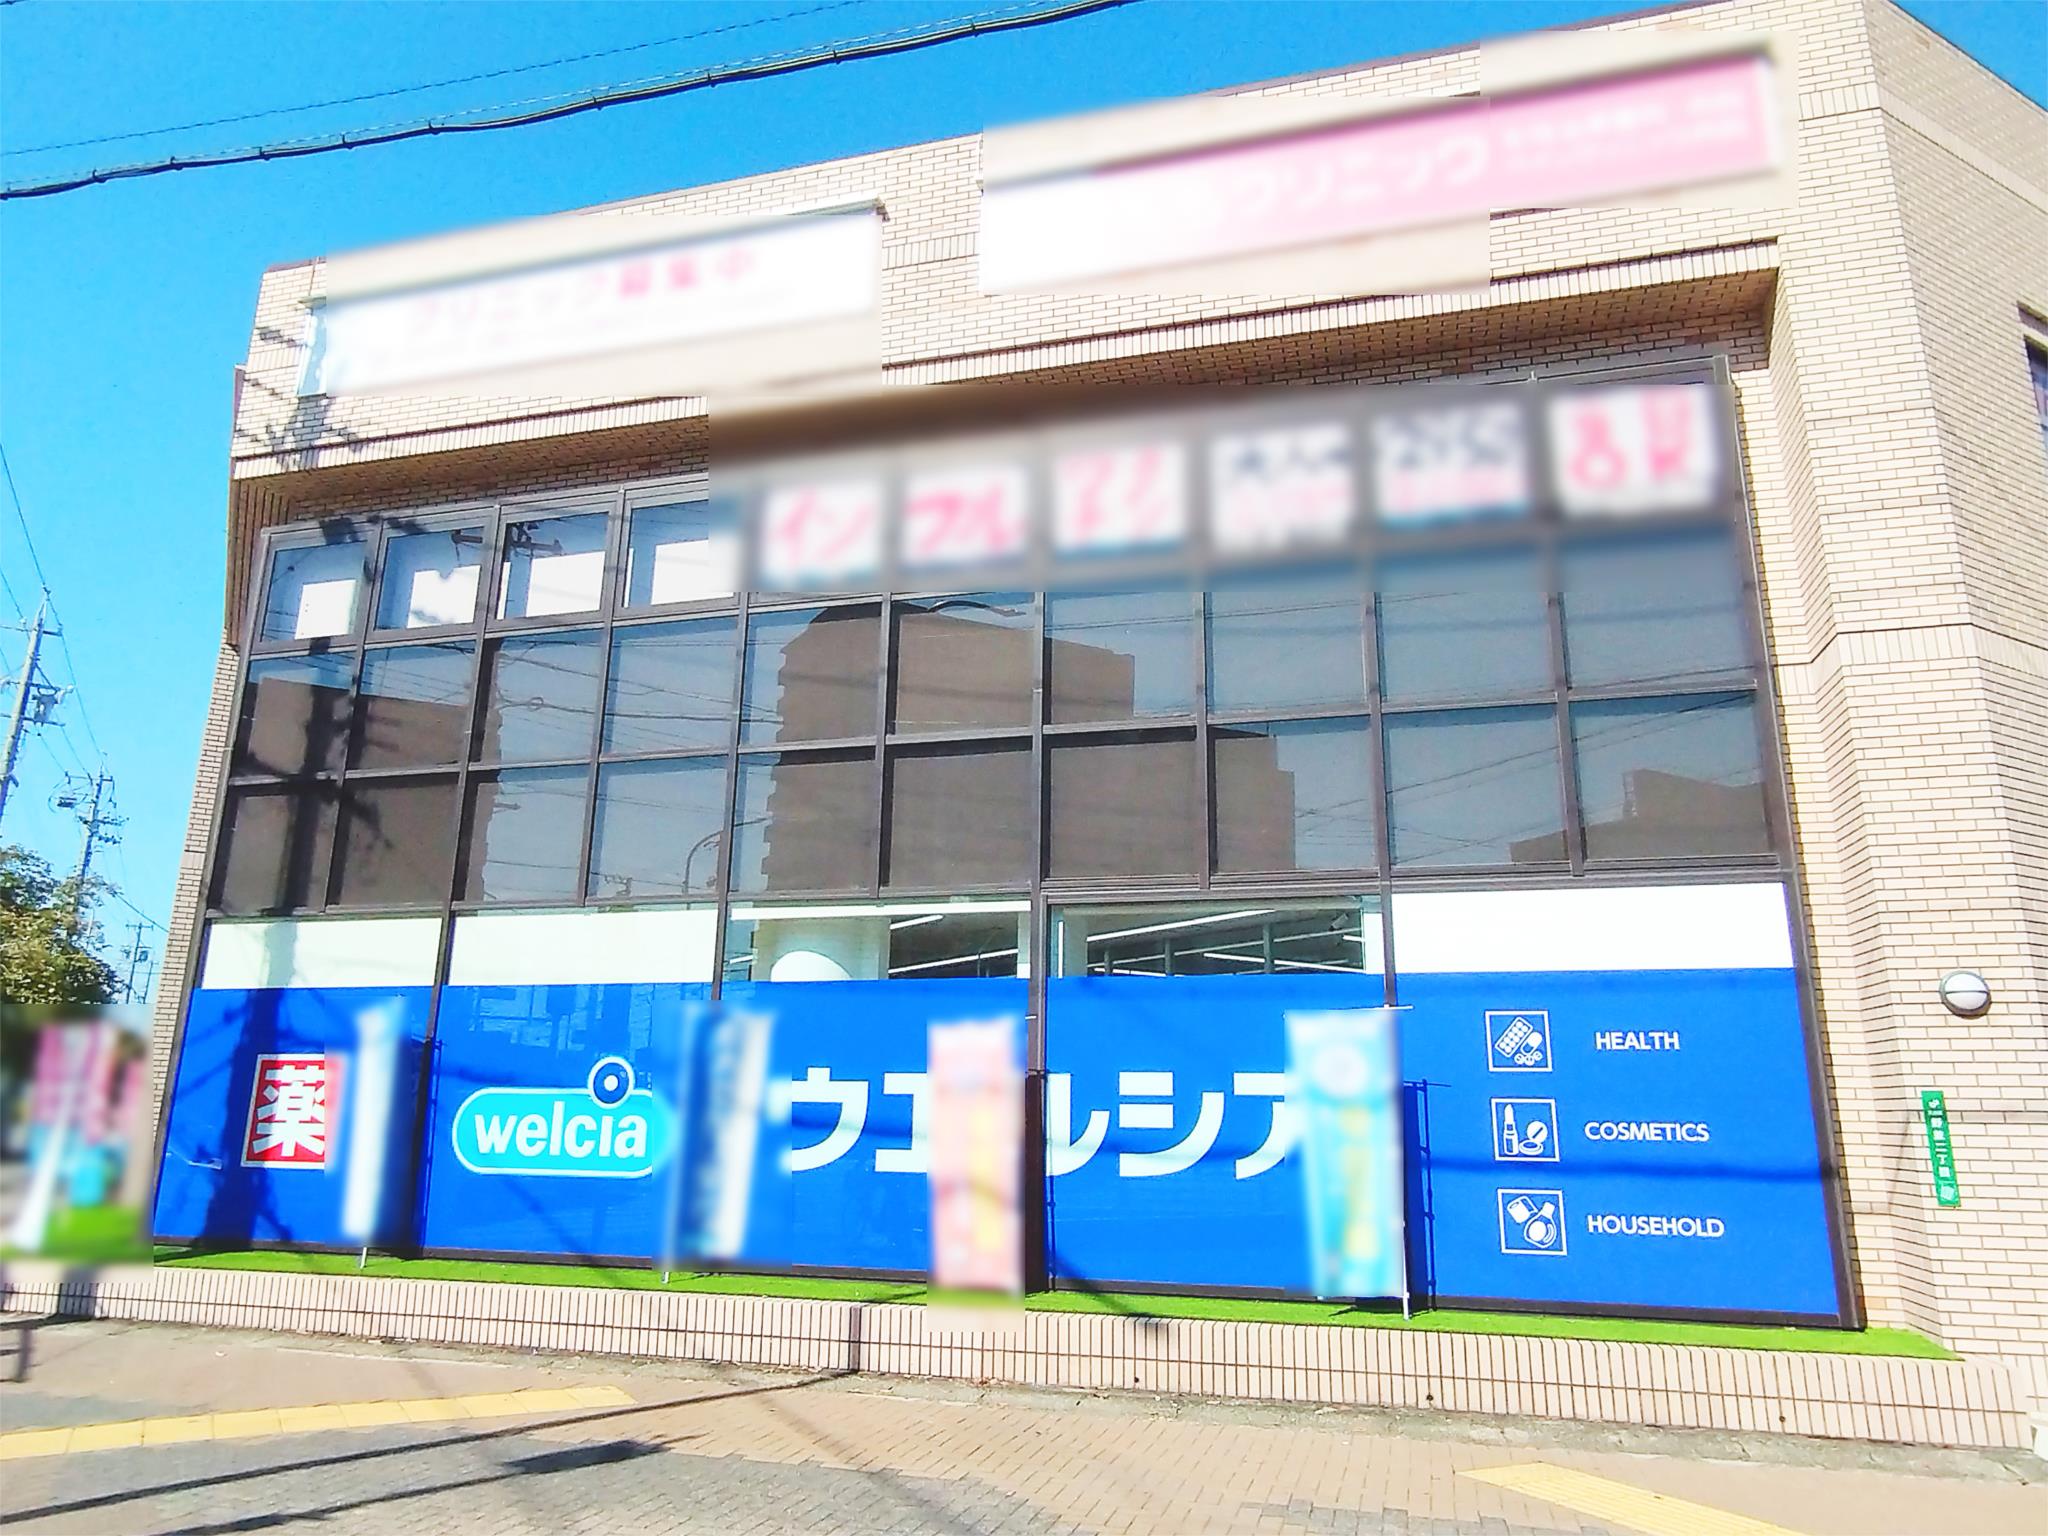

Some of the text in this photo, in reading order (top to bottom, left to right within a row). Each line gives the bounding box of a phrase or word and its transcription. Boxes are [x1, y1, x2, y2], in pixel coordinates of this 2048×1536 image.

[1595, 1031, 1680, 1050] HEALTH
[252, 1065, 328, 1158] 薬
[474, 1100, 648, 1159] welcia
[1584, 1121, 1710, 1142] COSMETICS
[1587, 1214, 1725, 1238] HOUSEHOLD
